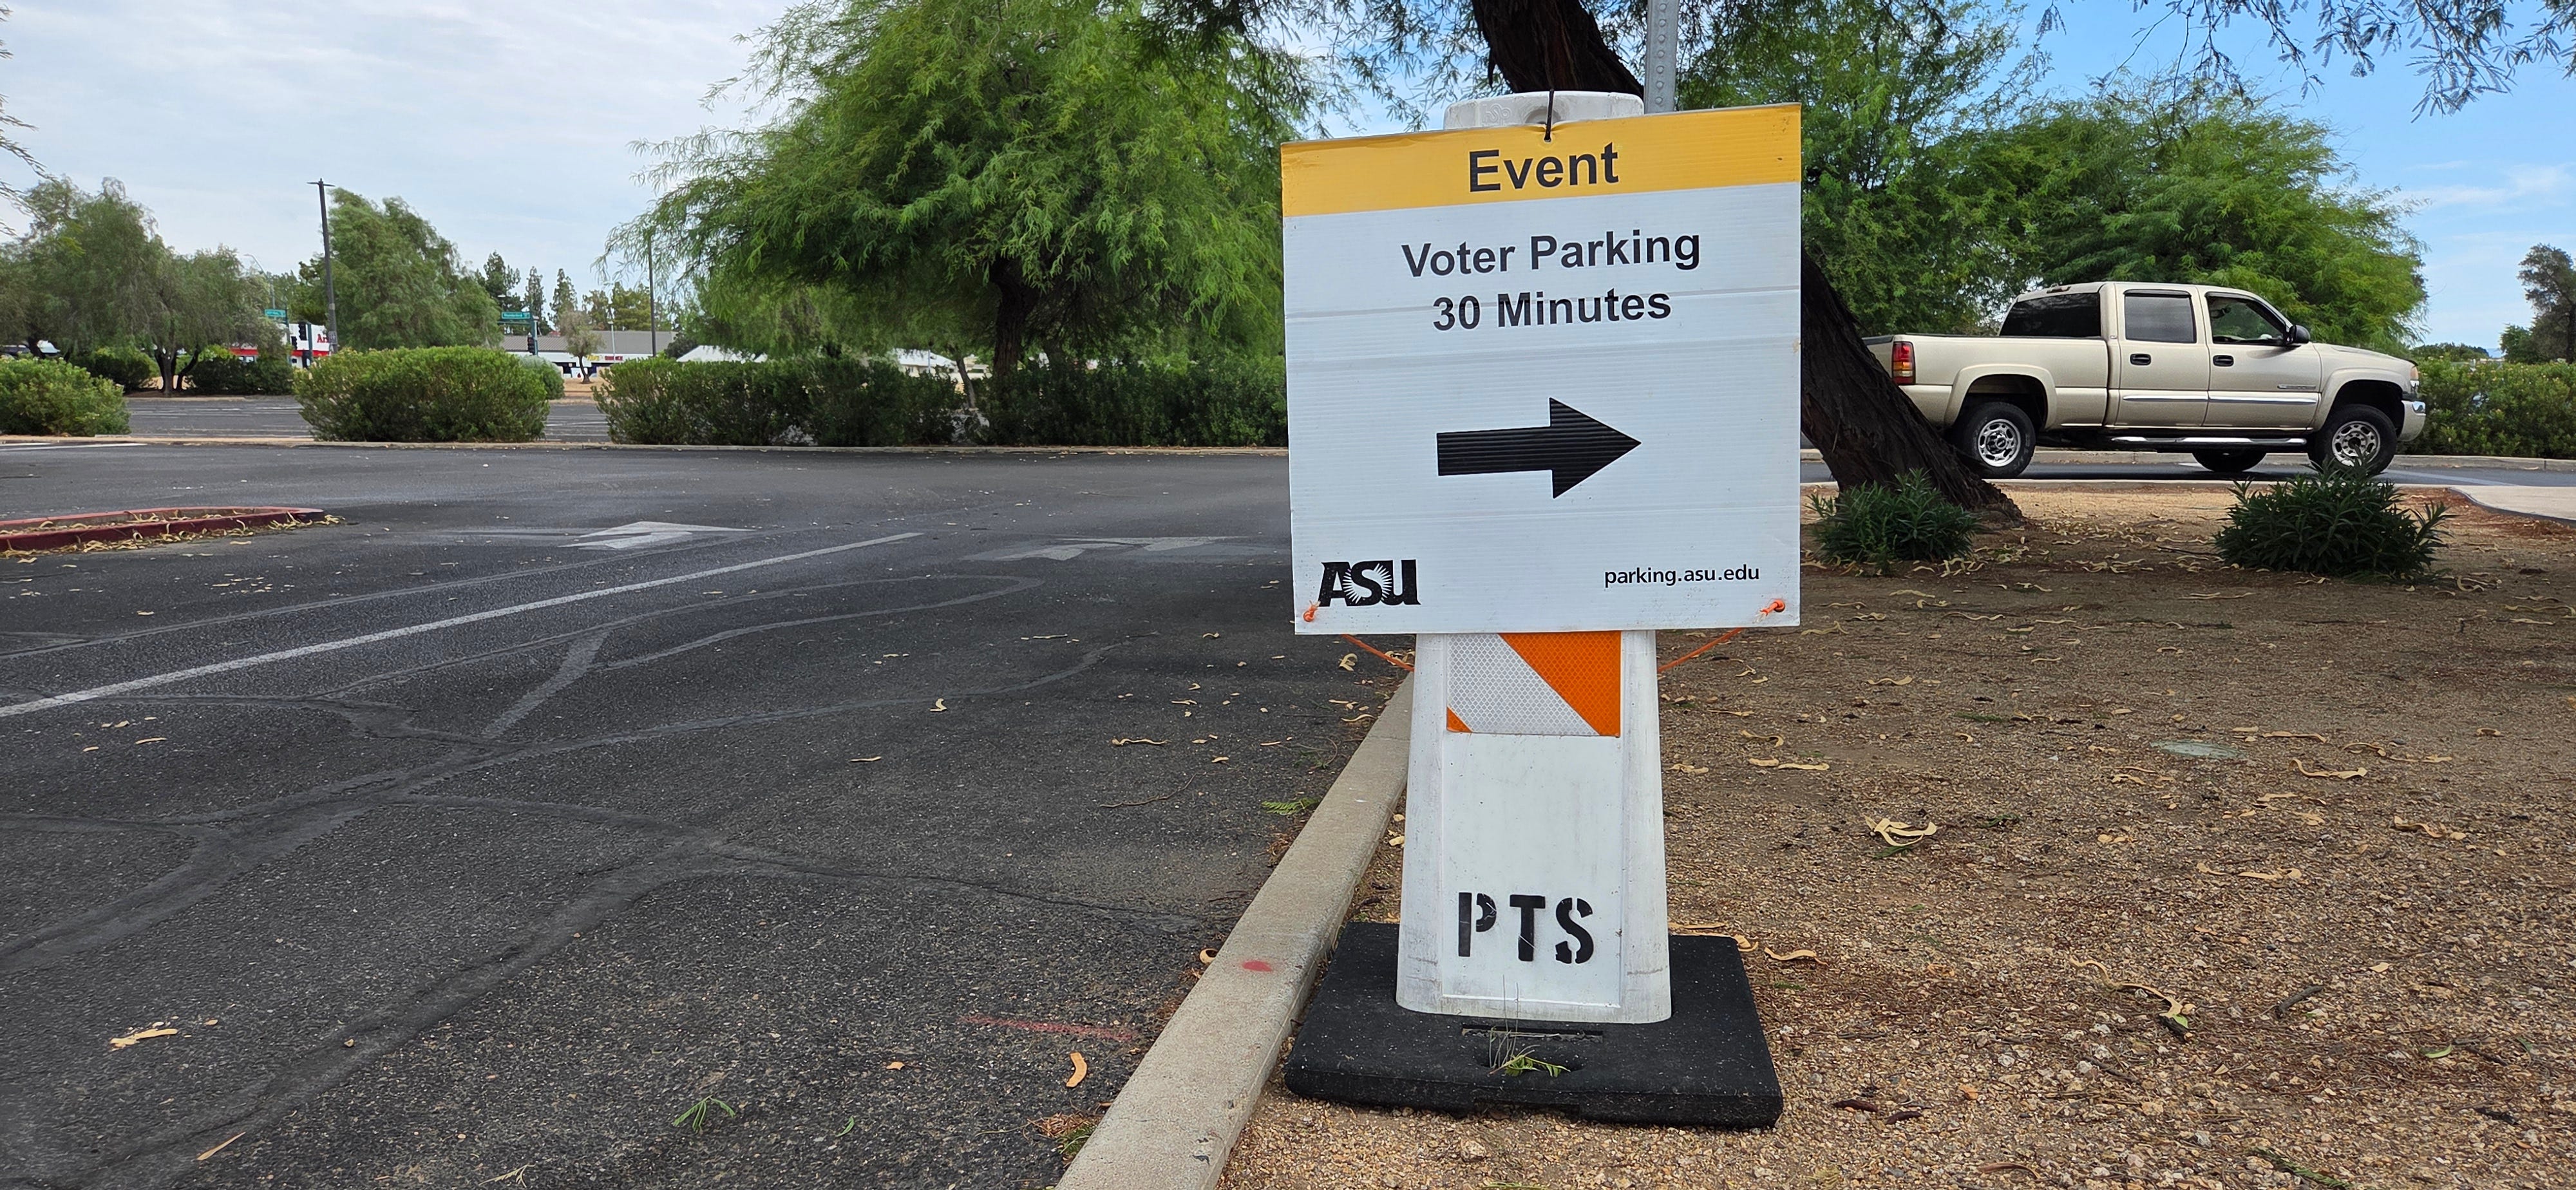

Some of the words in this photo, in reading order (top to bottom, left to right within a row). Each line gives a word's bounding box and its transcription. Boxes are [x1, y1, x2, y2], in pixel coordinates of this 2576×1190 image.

[1468, 142, 1619, 193] Event
[1401, 242, 1516, 278] Voter
[1530, 229, 1700, 270] Parking
[1433, 295, 1481, 331] 30
[1497, 287, 1672, 328] Minutes
[1318, 559, 1421, 607] ASU
[1604, 563, 1760, 589] parking.asu.edu
[1457, 891, 1595, 964] PTS
